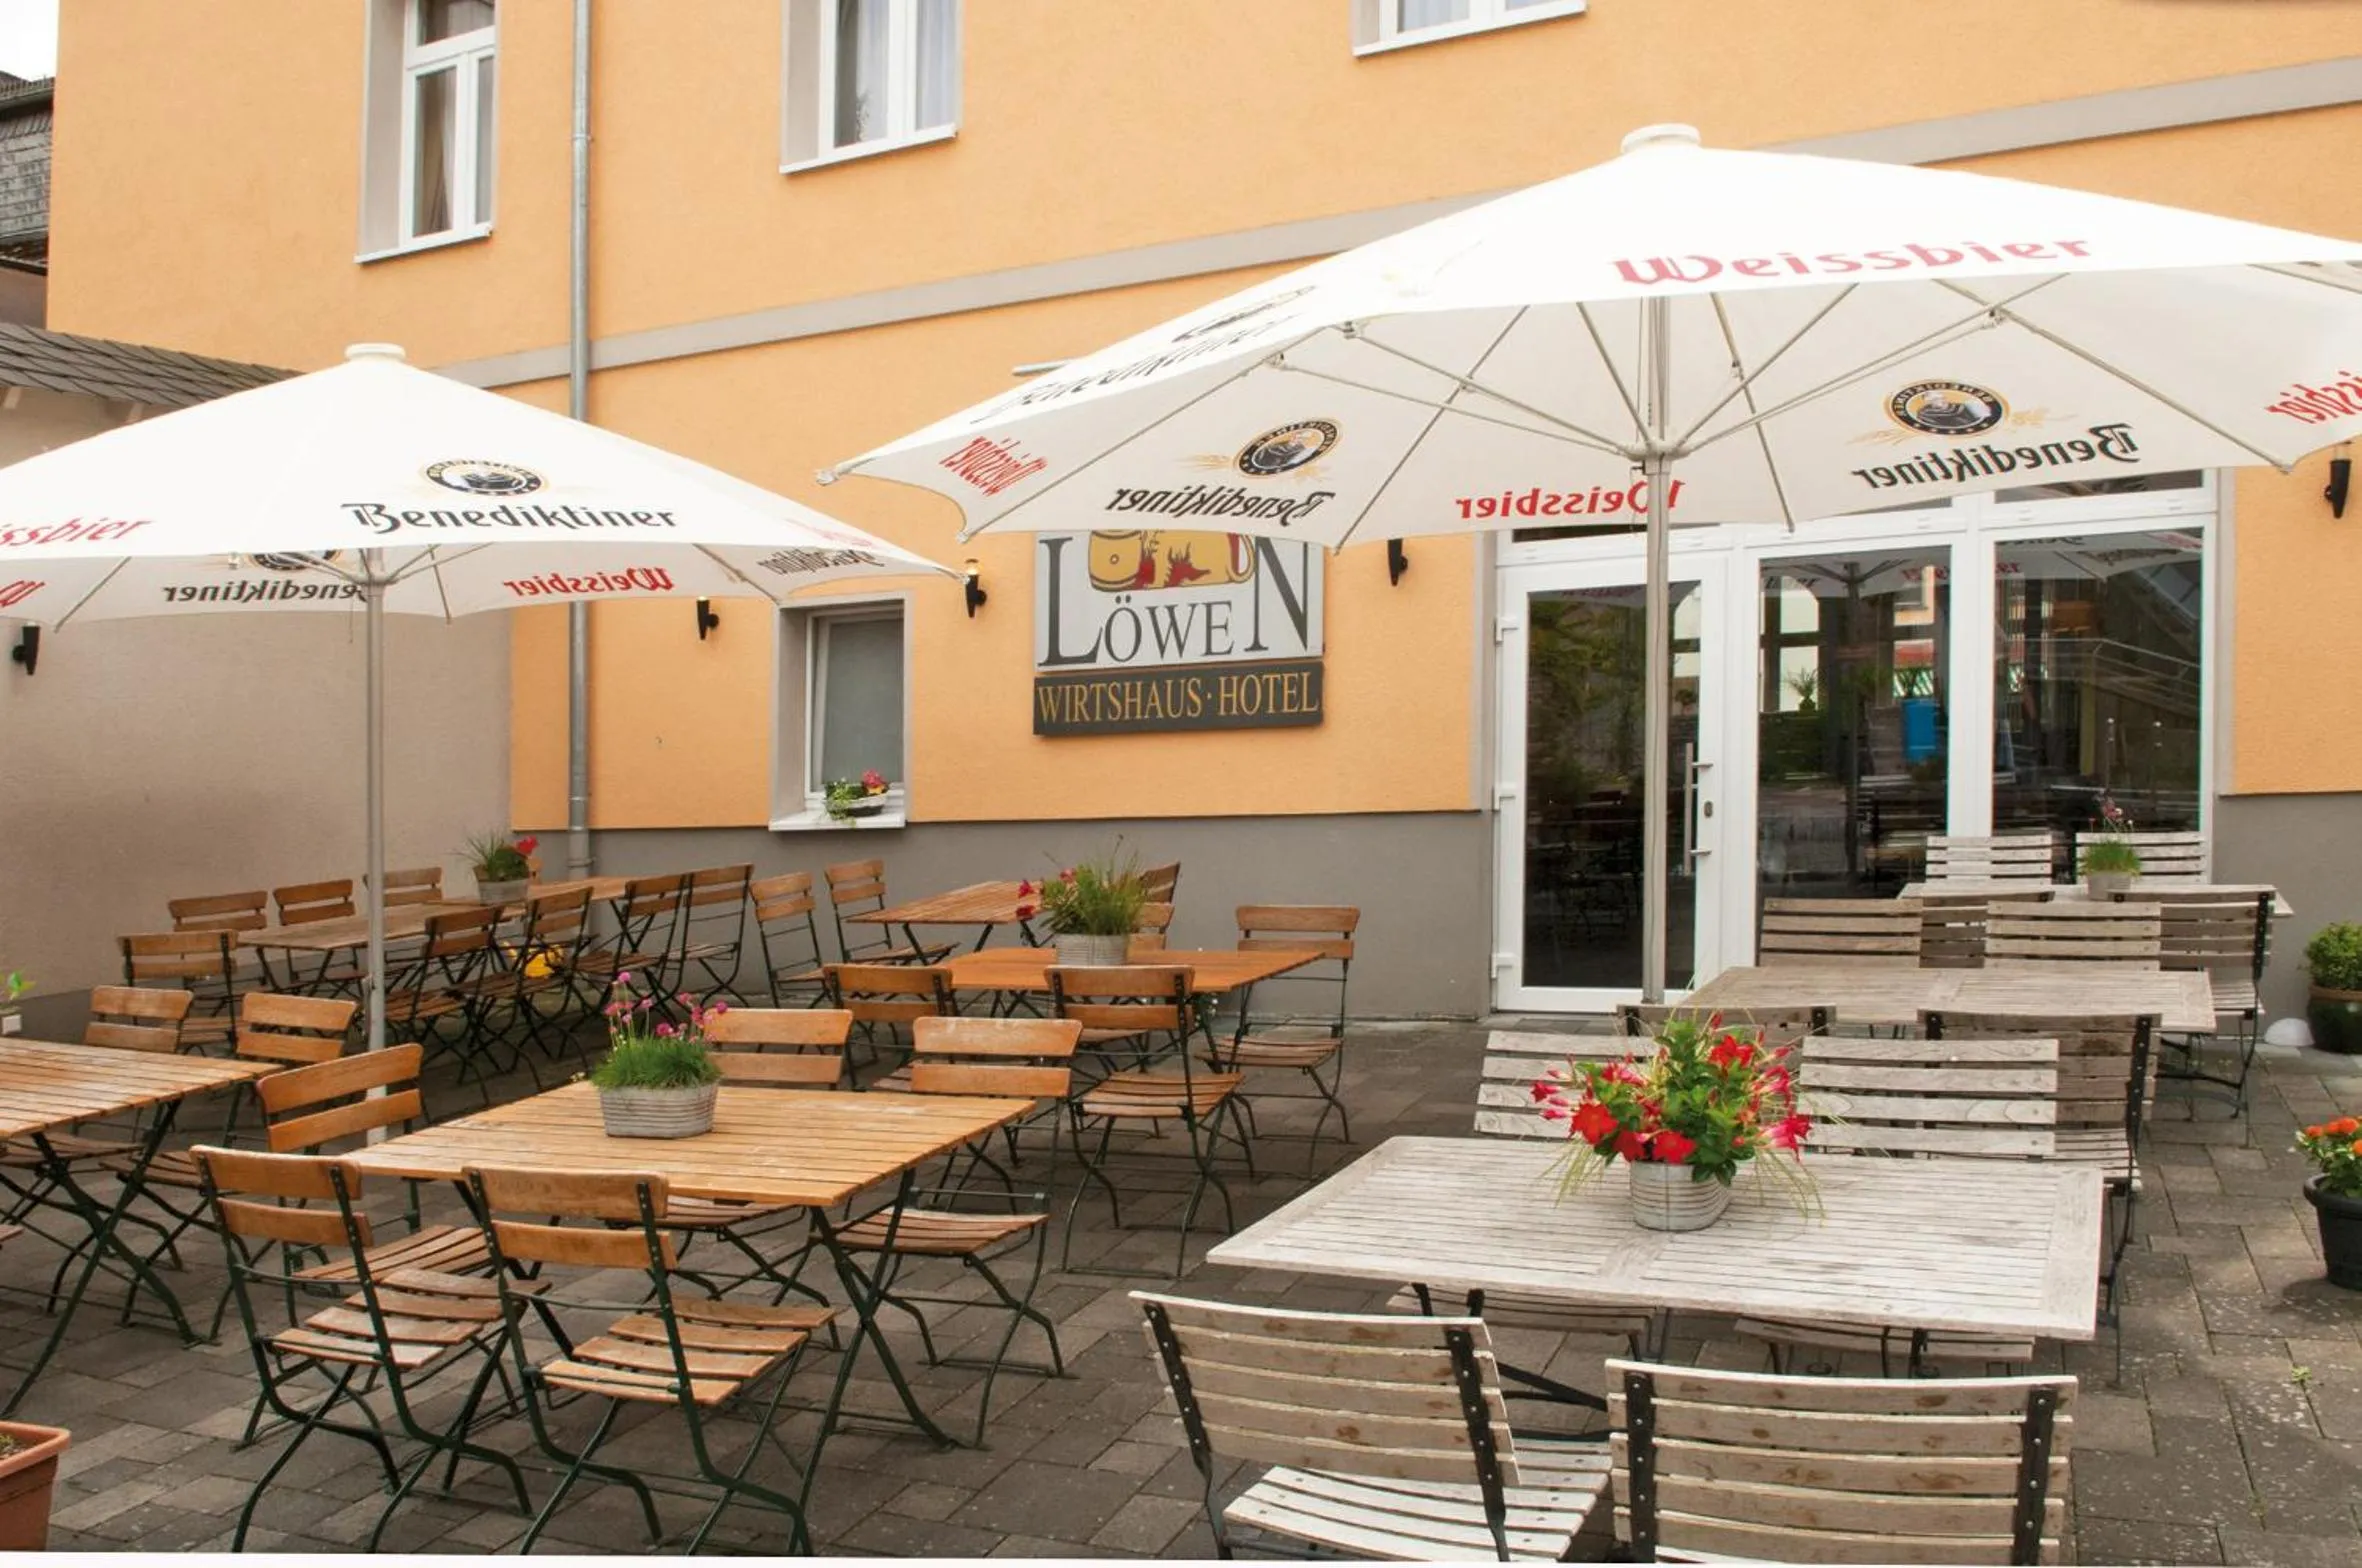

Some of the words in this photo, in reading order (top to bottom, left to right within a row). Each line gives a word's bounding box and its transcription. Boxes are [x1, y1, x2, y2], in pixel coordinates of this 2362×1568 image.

[1612, 241, 2090, 284] Weissbier
[0, 517, 155, 546] ssbier
[341, 503, 677, 534] Benediktiner
[1038, 536, 1309, 667] LÖWEN
[1038, 677, 1202, 723] WIRTSHAUS
[1218, 672, 1319, 716] HOTEL
